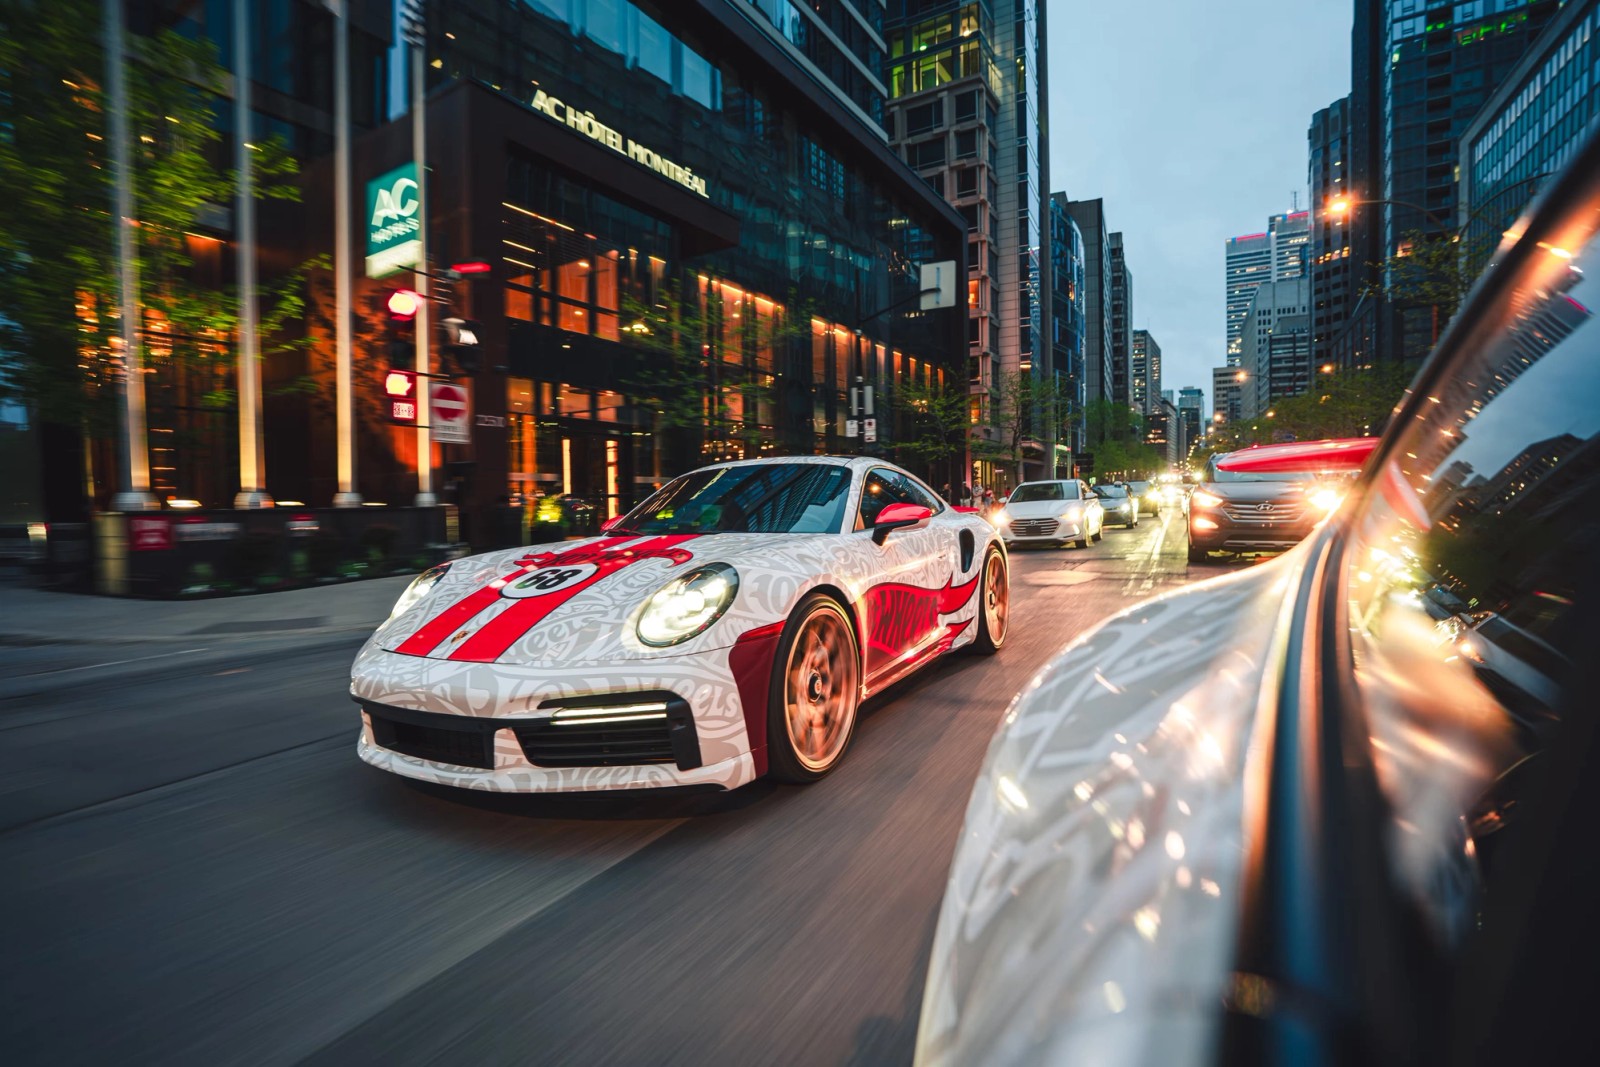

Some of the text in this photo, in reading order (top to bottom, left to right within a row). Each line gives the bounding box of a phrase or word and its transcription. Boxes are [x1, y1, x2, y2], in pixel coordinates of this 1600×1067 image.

[531, 89, 710, 199] AC HÔTEL MONTRÉAL
[371, 177, 419, 228] AC
[514, 568, 583, 591] 68
